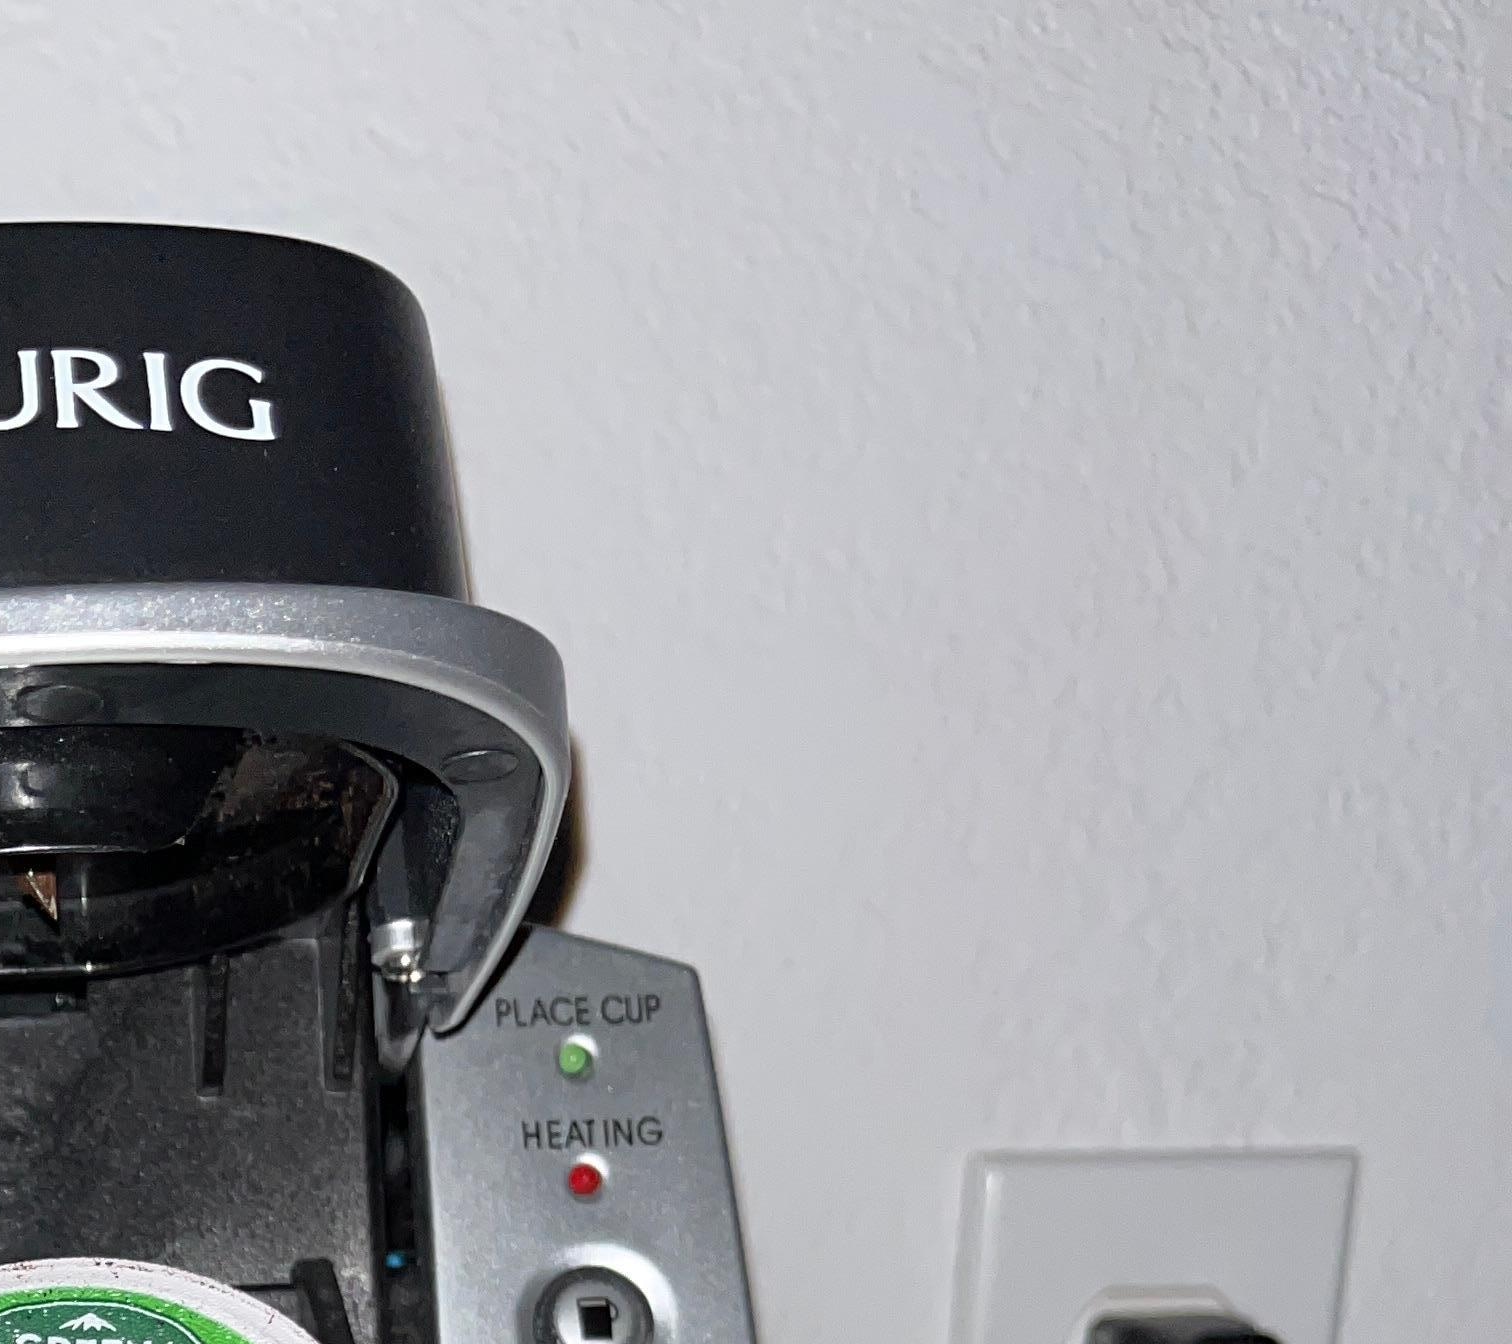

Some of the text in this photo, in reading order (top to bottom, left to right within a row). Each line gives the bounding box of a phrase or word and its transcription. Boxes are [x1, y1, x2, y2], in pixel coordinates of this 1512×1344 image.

[494, 993, 661, 1028] PLACE CUP
[521, 1115, 664, 1150] HEATING
